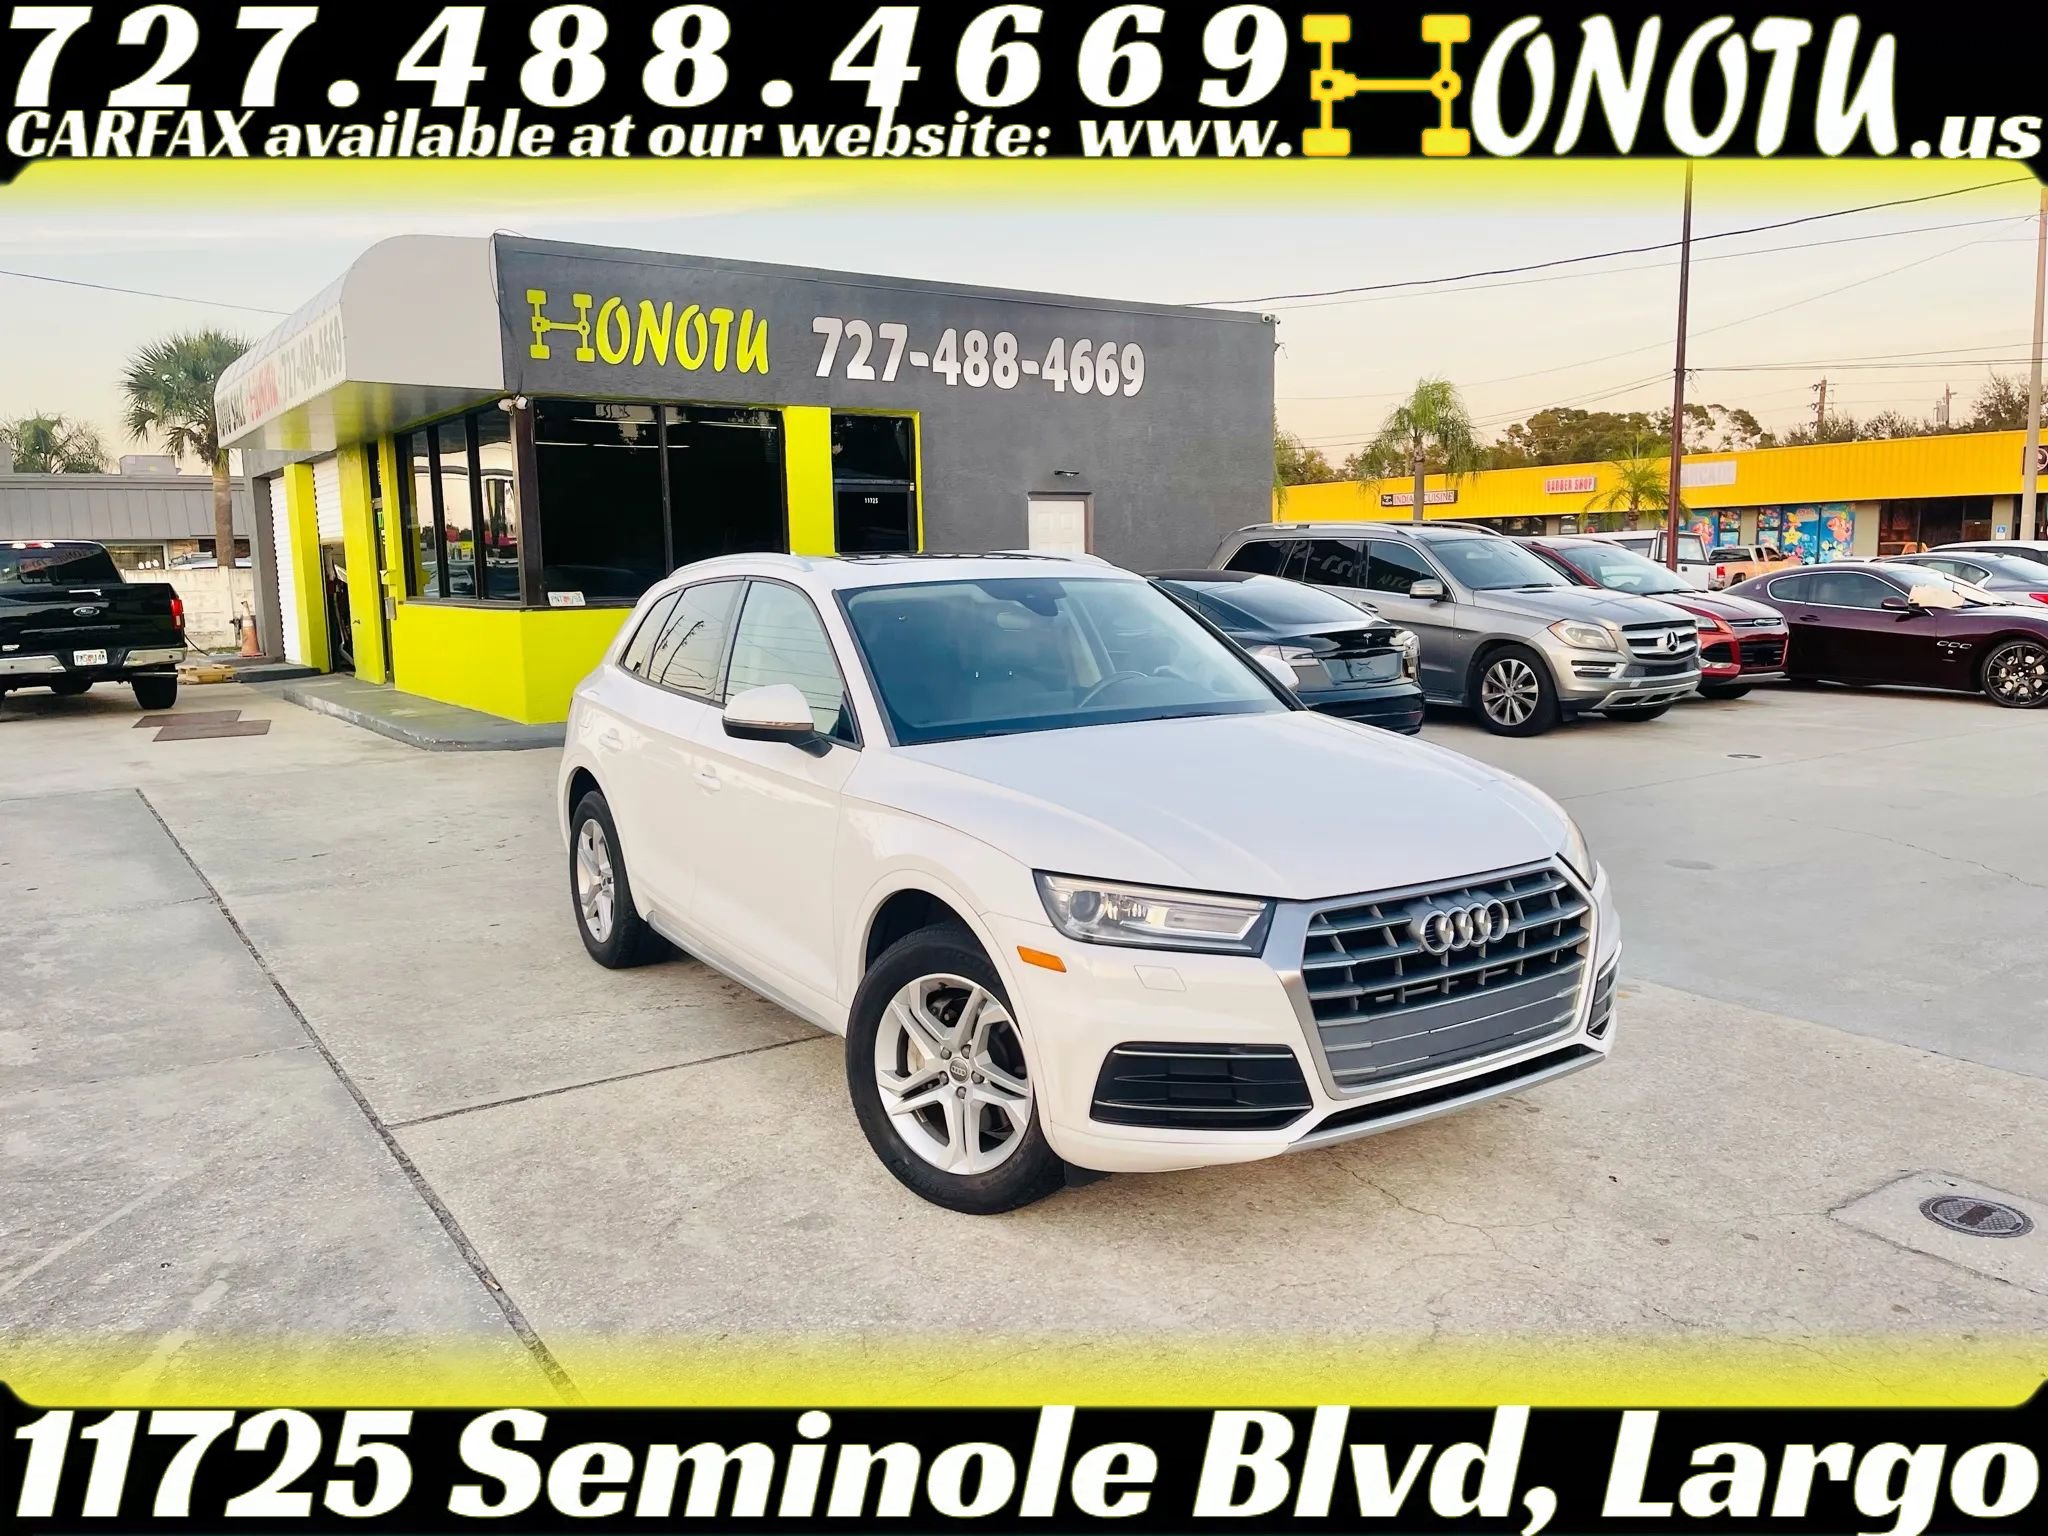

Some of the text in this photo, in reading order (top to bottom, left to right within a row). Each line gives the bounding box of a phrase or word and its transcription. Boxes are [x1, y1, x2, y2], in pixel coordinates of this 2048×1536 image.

[812, 316, 1146, 397] 727-488-4669
[1574, 478, 1593, 490] SHOP
[1393, 494, 1416, 504] INDIA
